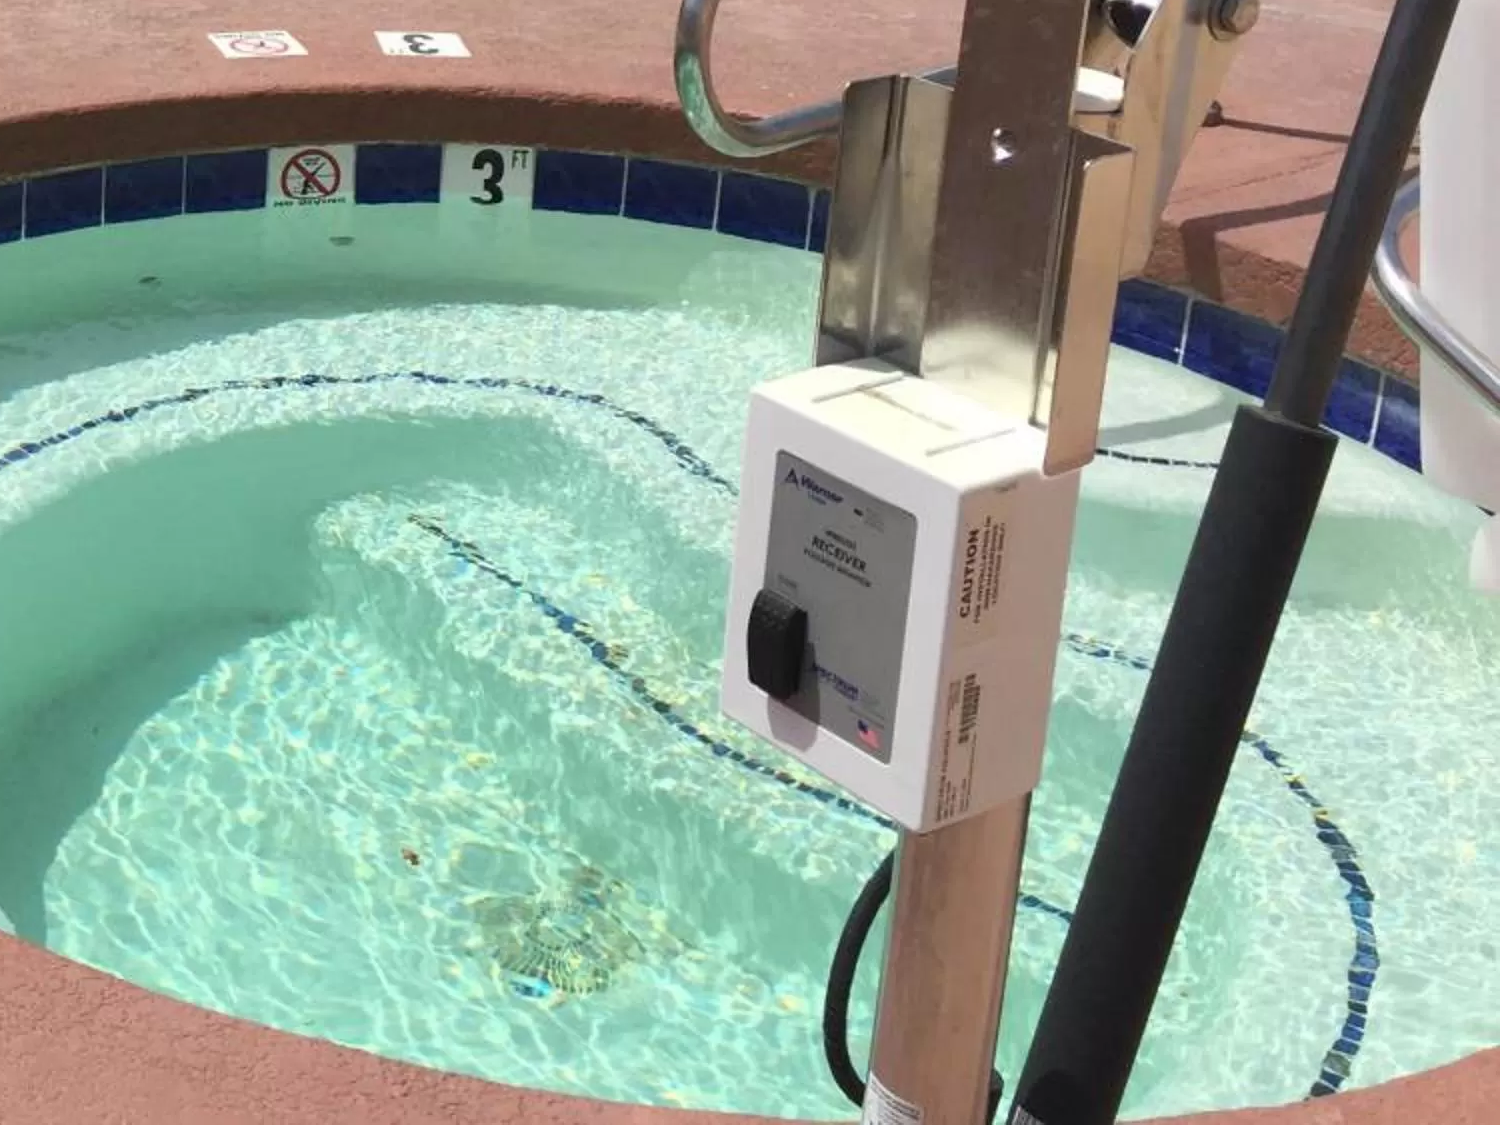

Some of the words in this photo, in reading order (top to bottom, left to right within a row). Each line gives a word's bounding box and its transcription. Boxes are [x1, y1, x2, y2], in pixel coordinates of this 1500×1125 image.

[402, 34, 439, 53] 3
[470, 148, 504, 206] 3
[512, 149, 529, 170] FT
[811, 535, 867, 572] RECEIVER
[960, 528, 980, 618] CAUTION
